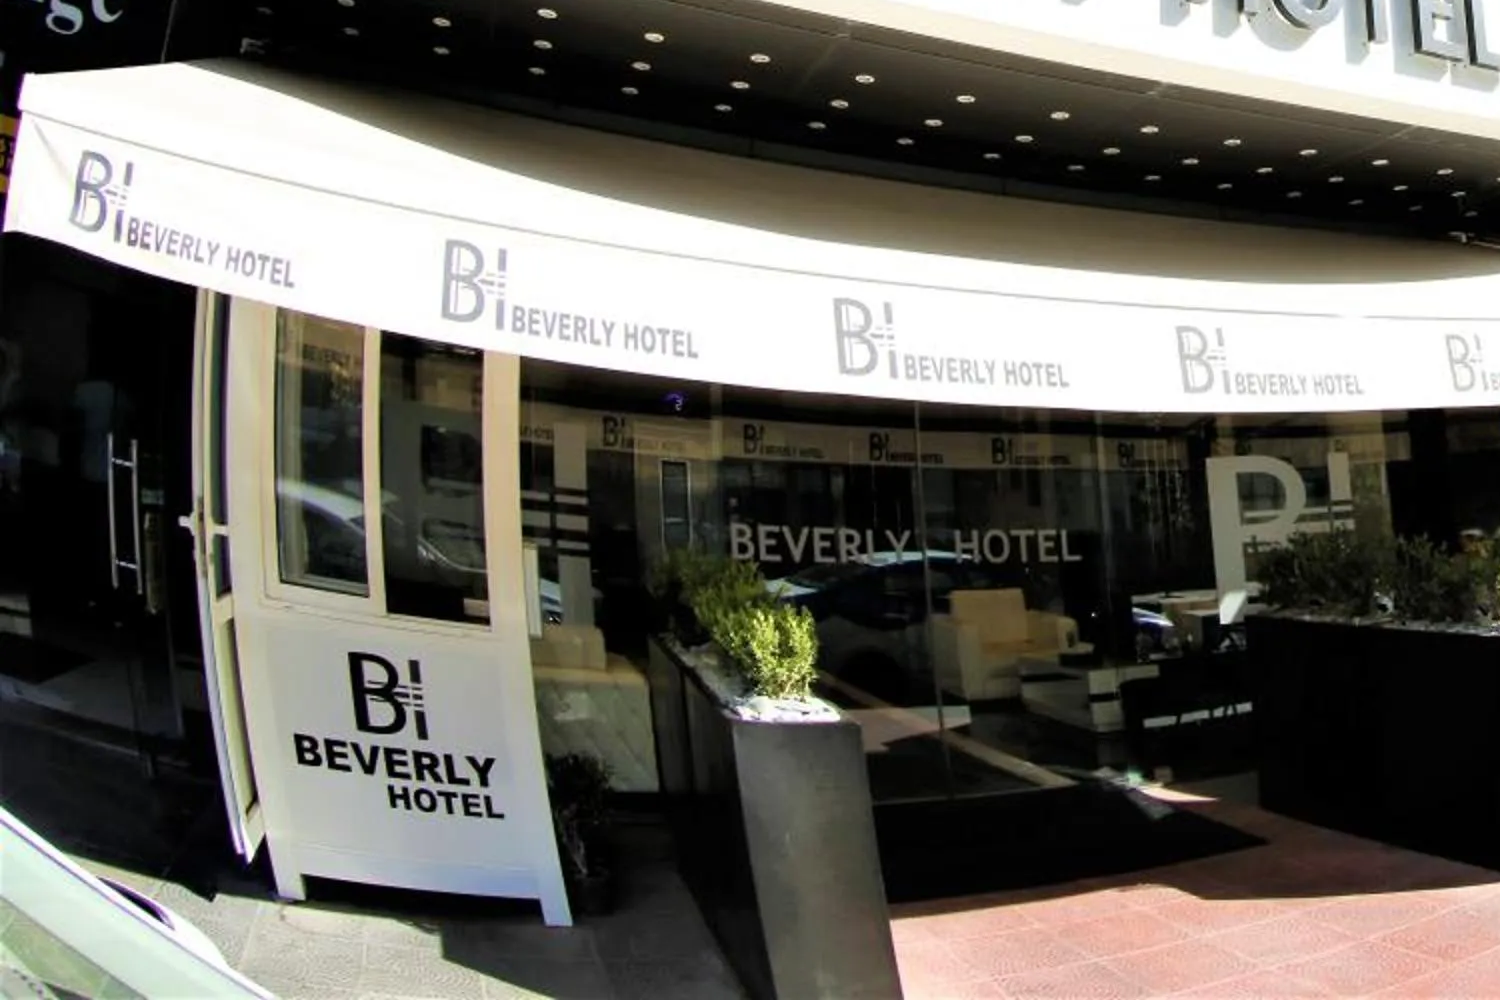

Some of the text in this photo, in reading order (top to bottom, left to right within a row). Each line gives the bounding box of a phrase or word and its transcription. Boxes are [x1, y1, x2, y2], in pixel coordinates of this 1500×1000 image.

[127, 216, 220, 266] BEVERLY
[224, 245, 295, 288] HOTEL
[511, 304, 615, 348] BEVERLY
[623, 322, 699, 359] HOTEL
[904, 353, 996, 386] BEVERLY
[1003, 360, 1070, 388] HOTEL
[1235, 372, 1307, 396] BEVERLY
[1313, 374, 1365, 396] HOTEL
[730, 522, 1083, 565] BEVERLY HOTEL
[294, 732, 497, 788] BEVERLY
[386, 784, 505, 820] HOTEL
